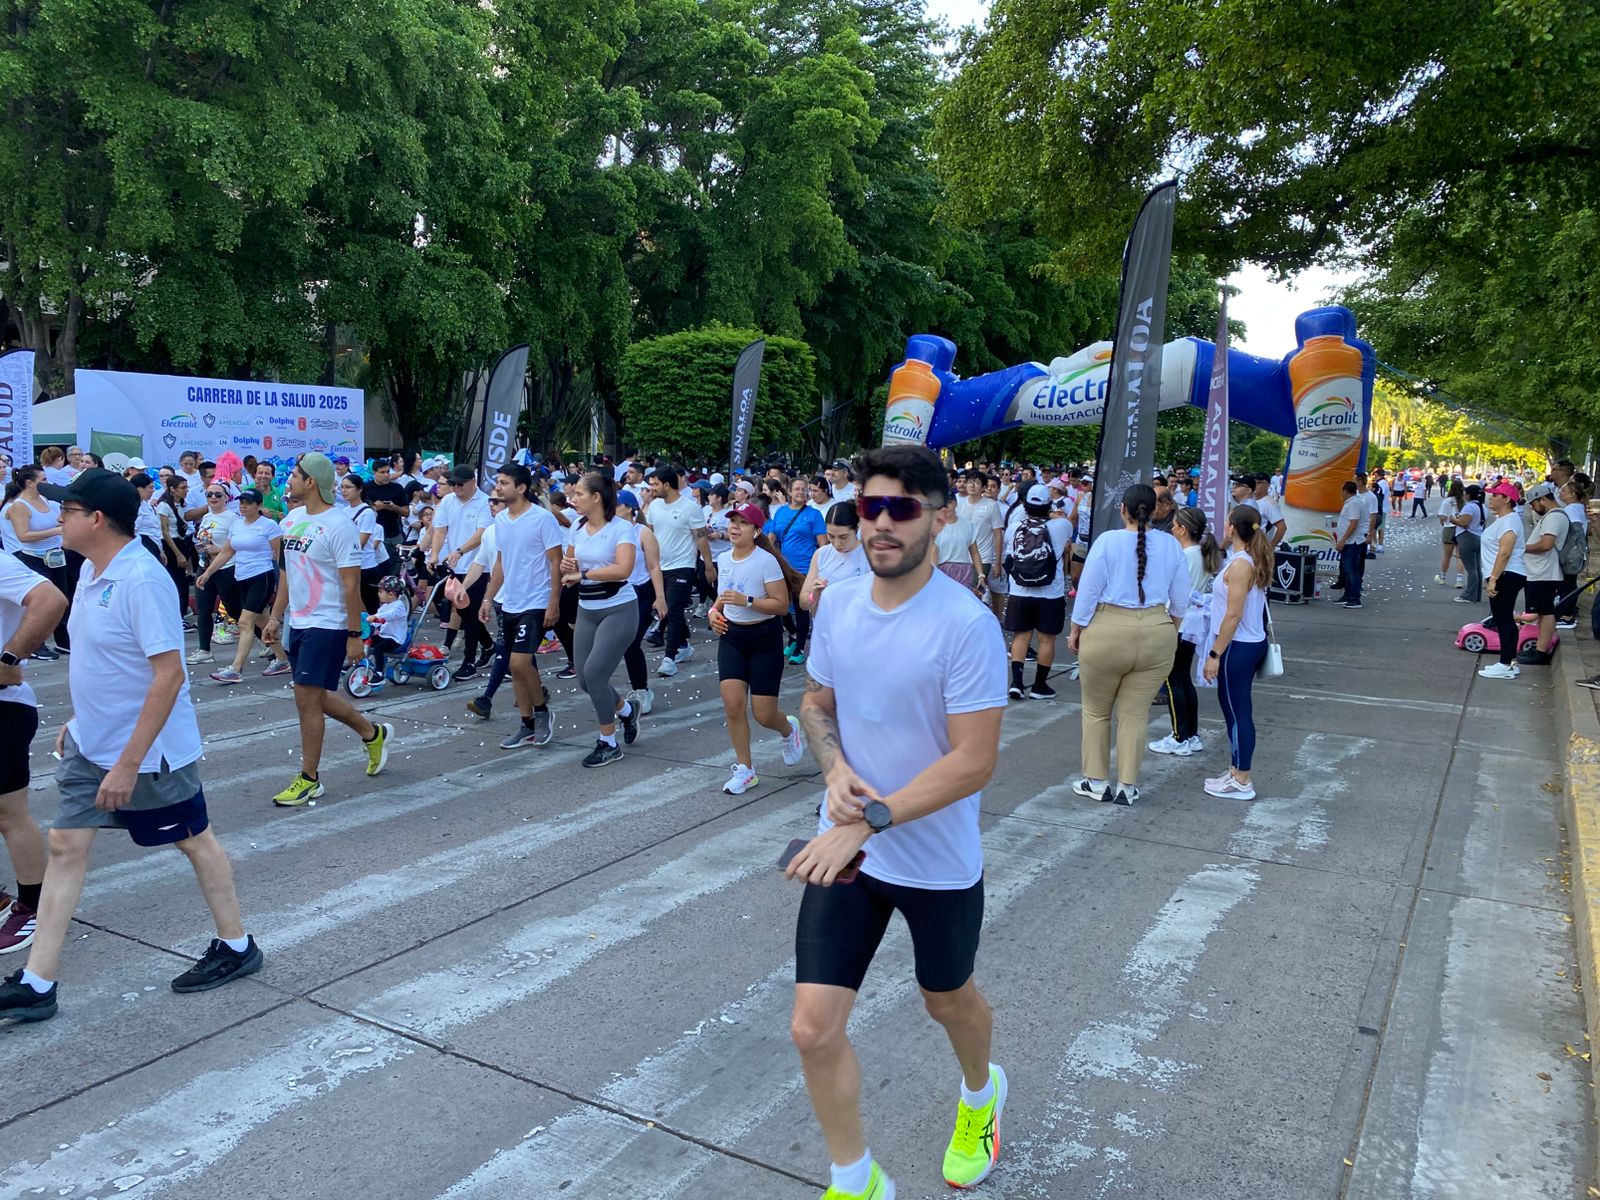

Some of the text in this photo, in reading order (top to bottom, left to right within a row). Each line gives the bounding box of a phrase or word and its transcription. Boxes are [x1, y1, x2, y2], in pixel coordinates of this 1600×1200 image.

[187, 386, 348, 410] CARRERA DE LA SALUD 2025
[0, 382, 14, 467] ALUD
[161, 419, 198, 429] Electrolit
[269, 416, 295, 426] Dolphy
[734, 388, 750, 464] SINALOA
[1298, 411, 1359, 430] Electrolit
[233, 436, 260, 446] Dolphy
